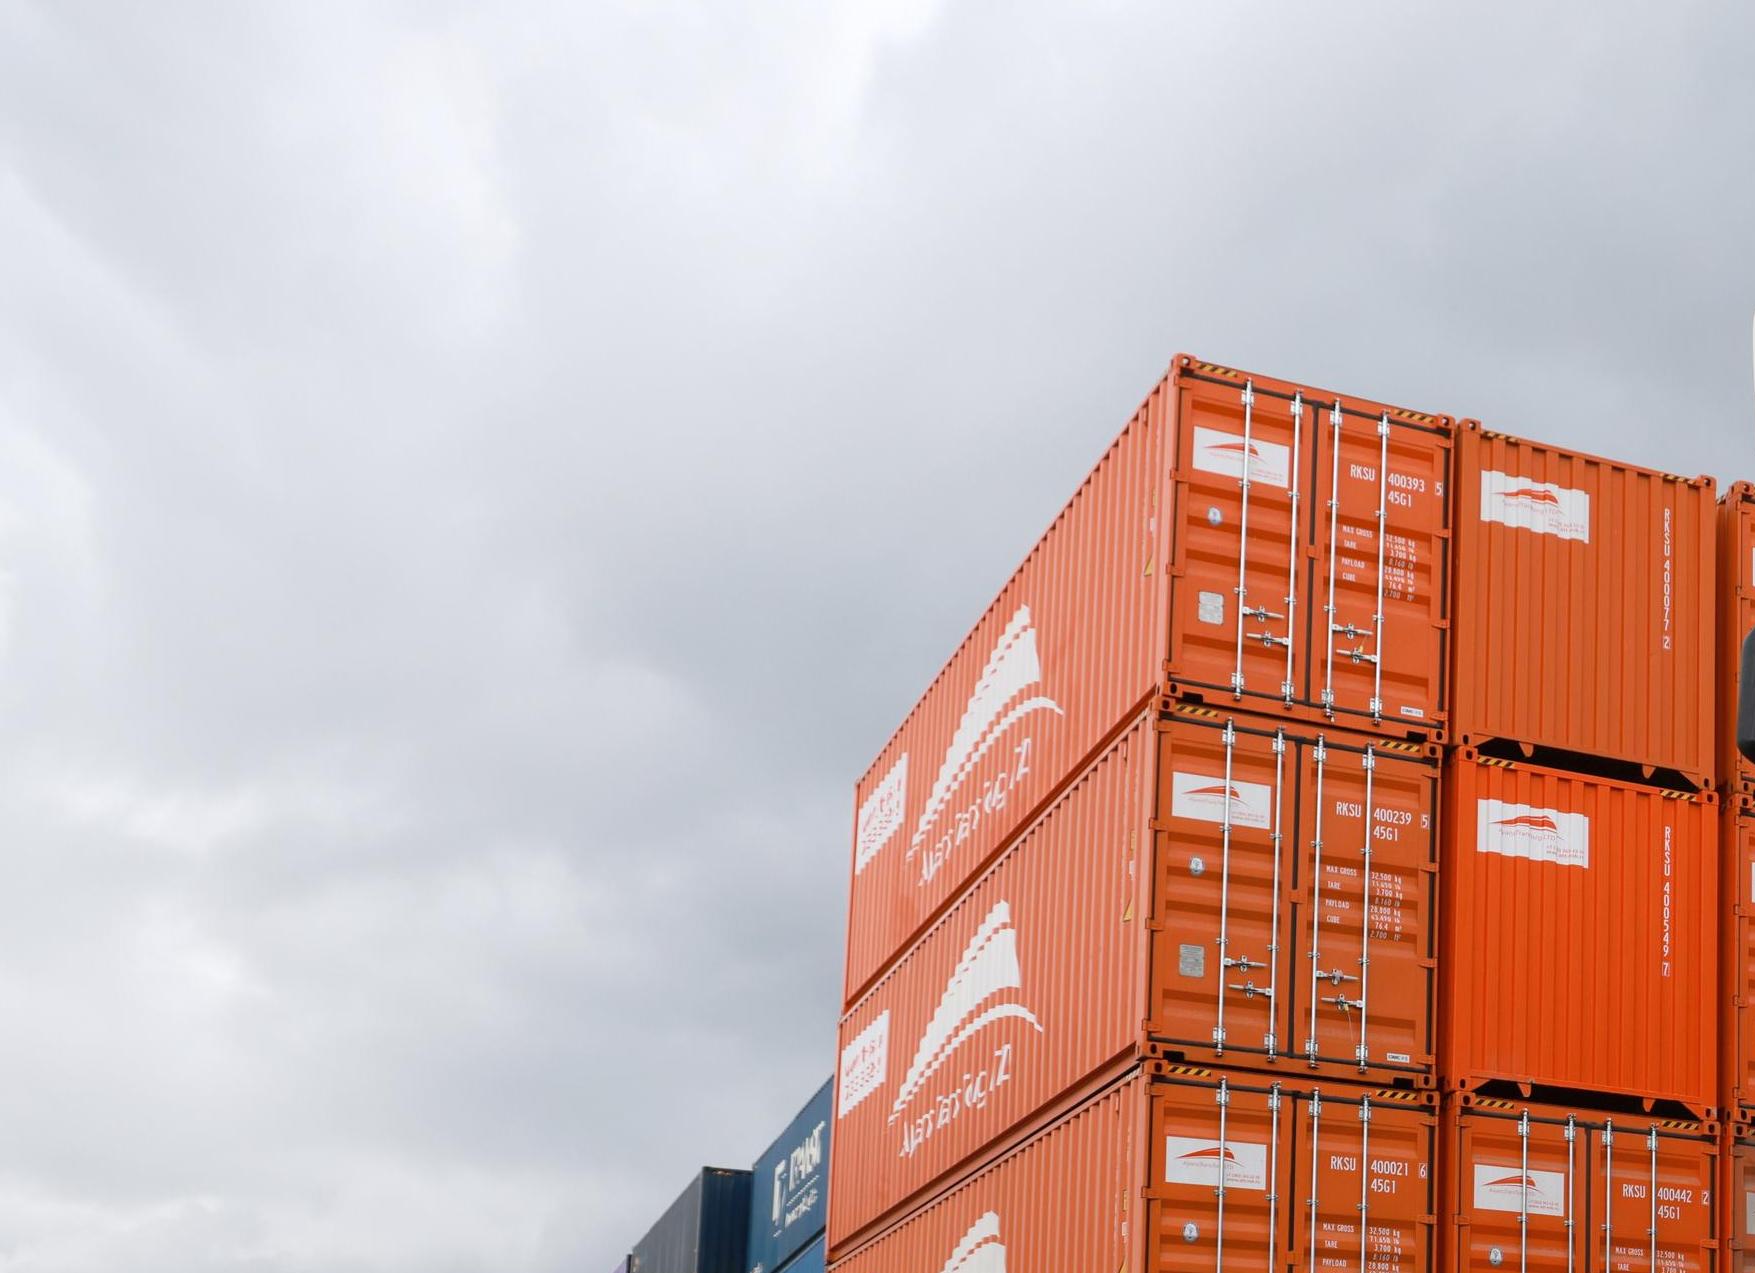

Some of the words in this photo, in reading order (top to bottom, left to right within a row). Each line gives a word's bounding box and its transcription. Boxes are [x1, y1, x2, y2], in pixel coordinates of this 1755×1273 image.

[1351, 464, 1375, 481] RKSU
[1388, 473, 1424, 491] 400393
[1388, 491, 1411, 506] 45G1
[1336, 802, 1361, 817] RKSU
[1374, 808, 1412, 824] 400239
[1374, 826, 1397, 841] 45G1
[1331, 1156, 1356, 1171] RKSU
[1371, 1160, 1408, 1176] 400021
[1371, 1179, 1396, 1193] 45G1
[1623, 1184, 1645, 1198] RKSU
[1658, 1187, 1692, 1203] 400442
[1658, 1206, 1679, 1220] 45G1
[1337, 1225, 1354, 1233] GROSS
[1325, 1240, 1338, 1248] TARE
[1323, 1259, 1346, 1267] PAYLOAD
